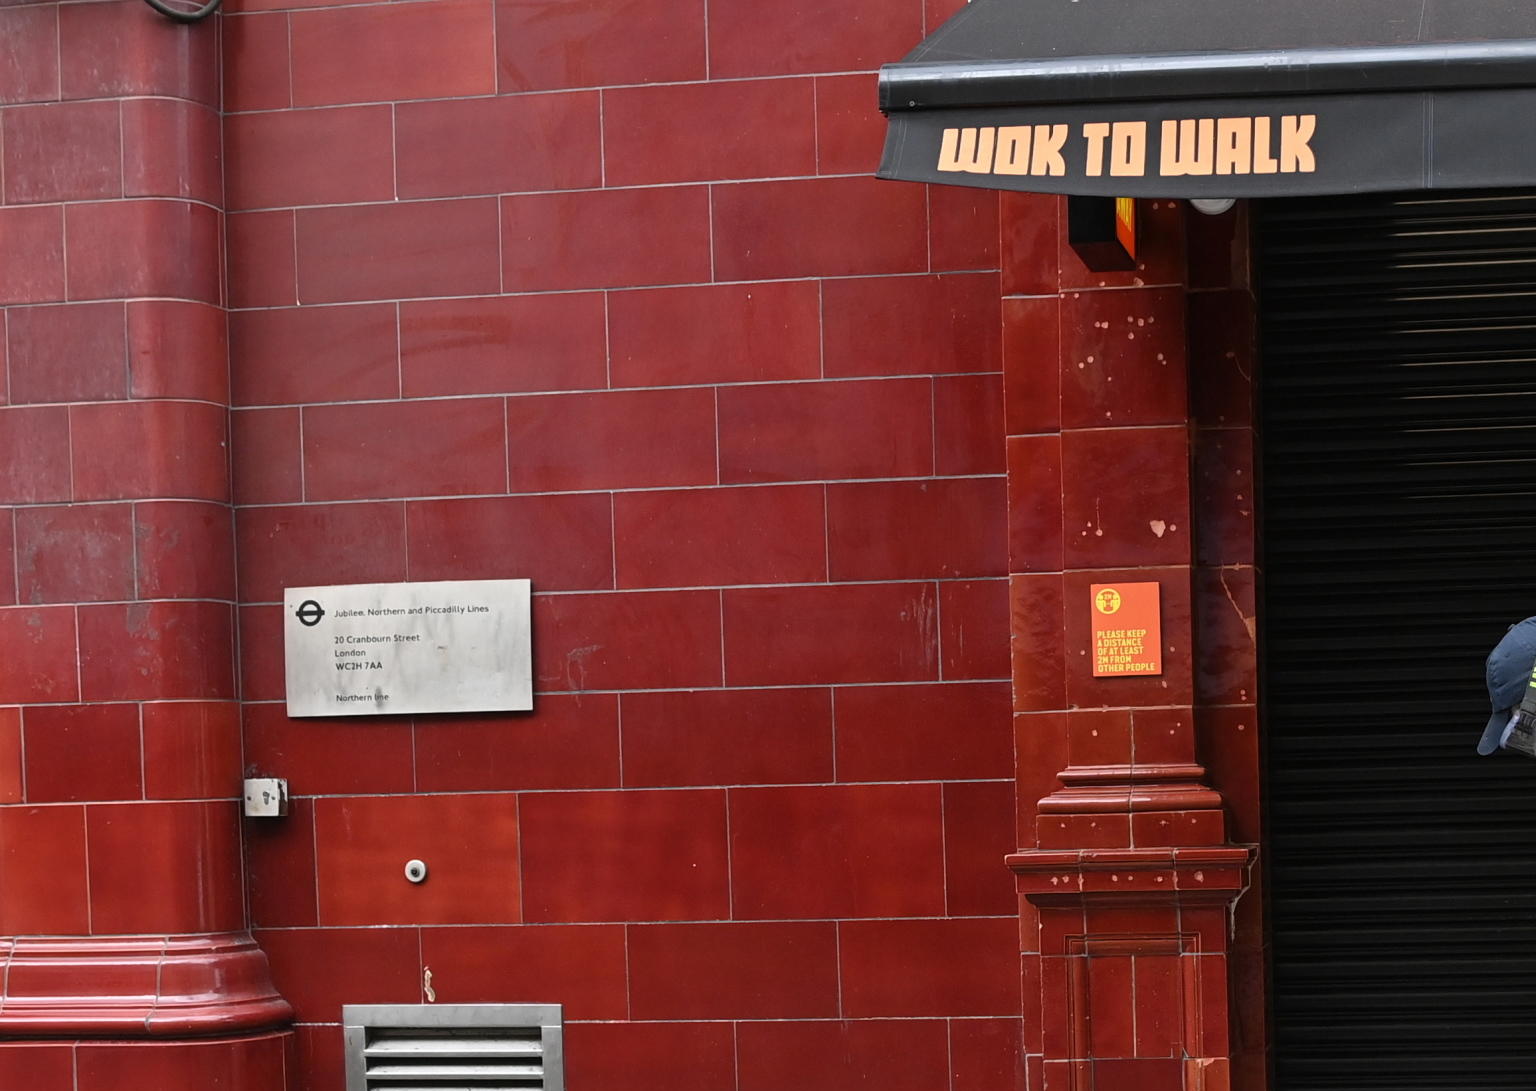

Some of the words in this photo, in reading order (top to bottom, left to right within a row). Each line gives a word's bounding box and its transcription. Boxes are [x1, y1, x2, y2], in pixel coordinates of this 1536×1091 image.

[937, 123, 1068, 177] WOK
[1082, 120, 1147, 177] TO
[1159, 114, 1316, 177] WALK
[367, 608, 406, 616] Northern
[407, 607, 423, 615] and
[425, 605, 465, 615] Piccadilly
[467, 605, 489, 613] Lines
[334, 636, 344, 644] 20
[346, 635, 391, 644] Cranbourn
[394, 634, 421, 642] Street
[1097, 630, 1125, 639] PLEASE
[1127, 629, 1147, 637] KEEP
[1097, 639, 1103, 647] A
[1104, 638, 1142, 646] DISTANCE
[335, 649, 366, 657] London
[1097, 647, 1107, 656] OF
[1109, 647, 1118, 655] AT
[1120, 646, 1144, 654] LEAST
[1097, 656, 1109, 664] 2M
[1110, 655, 1132, 663] FROM
[336, 662, 362, 670] WC2H
[364, 661, 383, 670] 7AA
[1098, 664, 1124, 672] OTHER
[1126, 662, 1155, 671] PEOPLE
[336, 694, 372, 702] Northern
